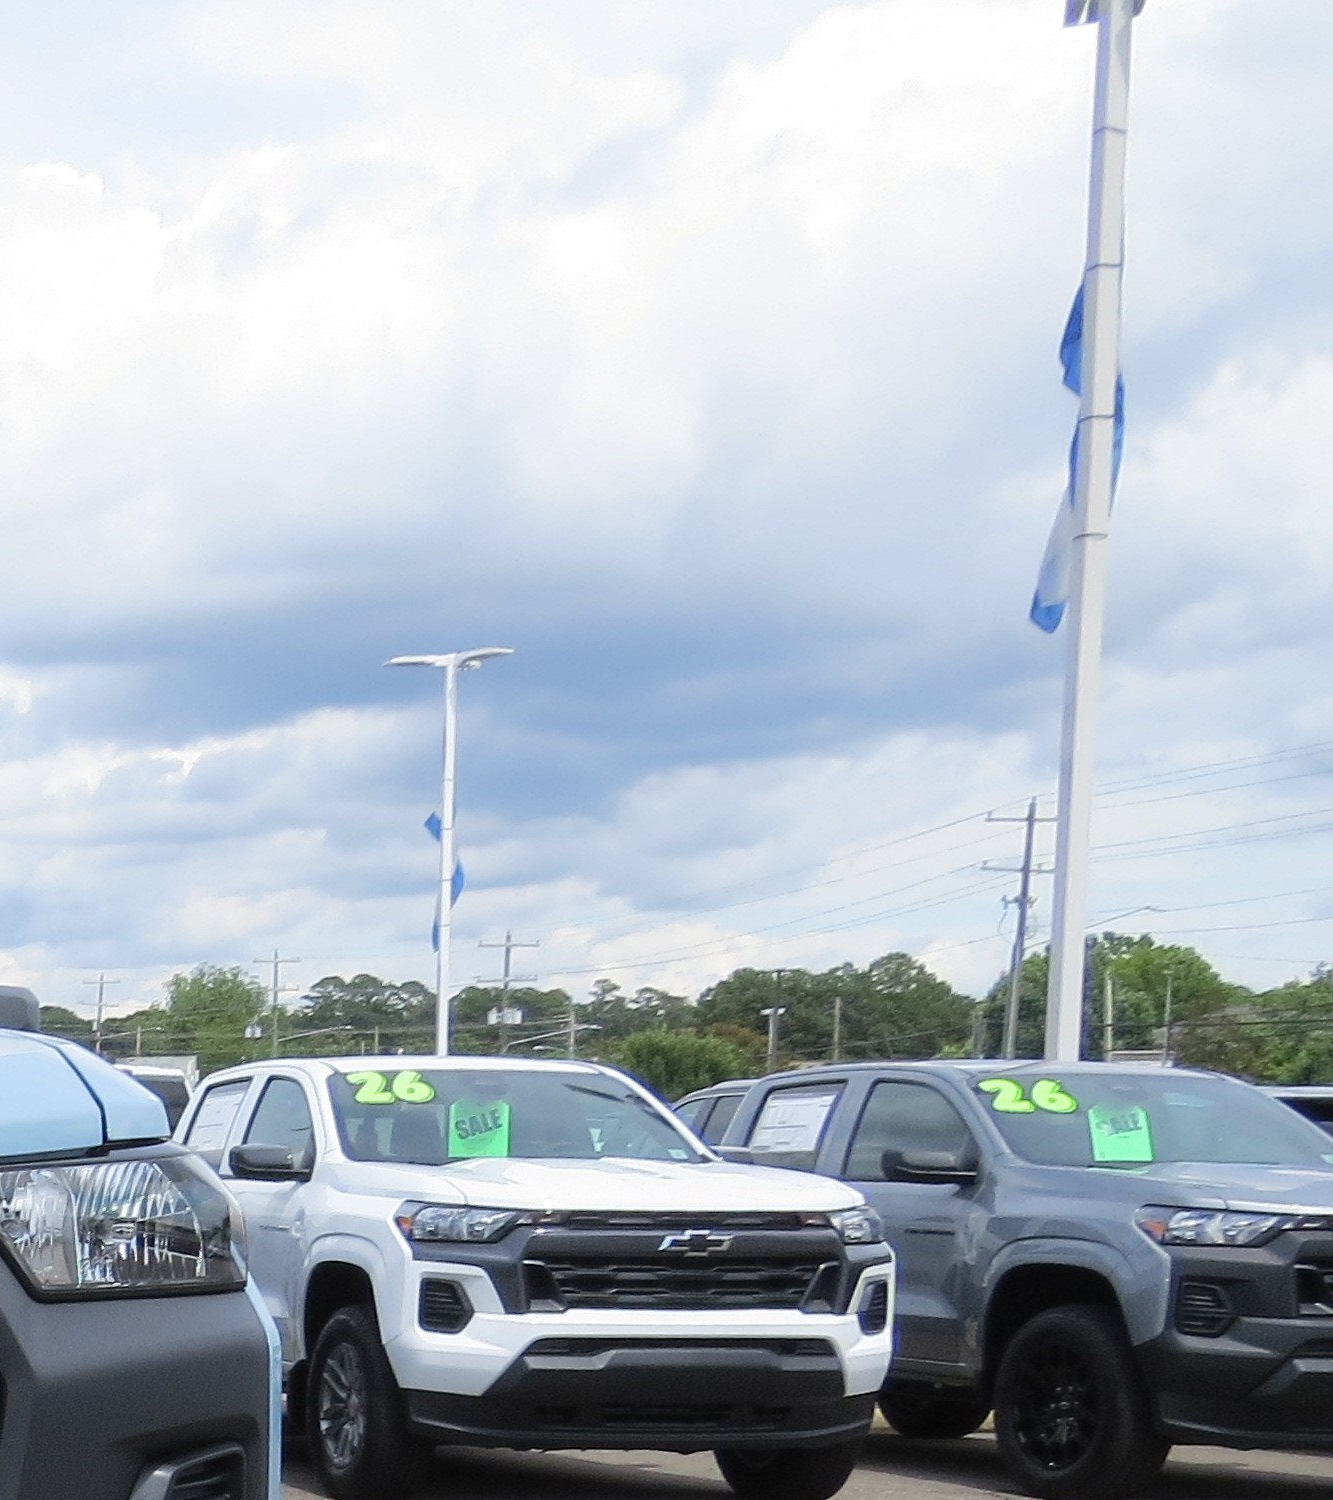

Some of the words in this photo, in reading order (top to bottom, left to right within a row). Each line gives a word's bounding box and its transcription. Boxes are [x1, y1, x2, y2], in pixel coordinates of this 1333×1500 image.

[344, 1070, 437, 1104] 26
[977, 1077, 1078, 1114] 26
[454, 1108, 503, 1140] SALE
